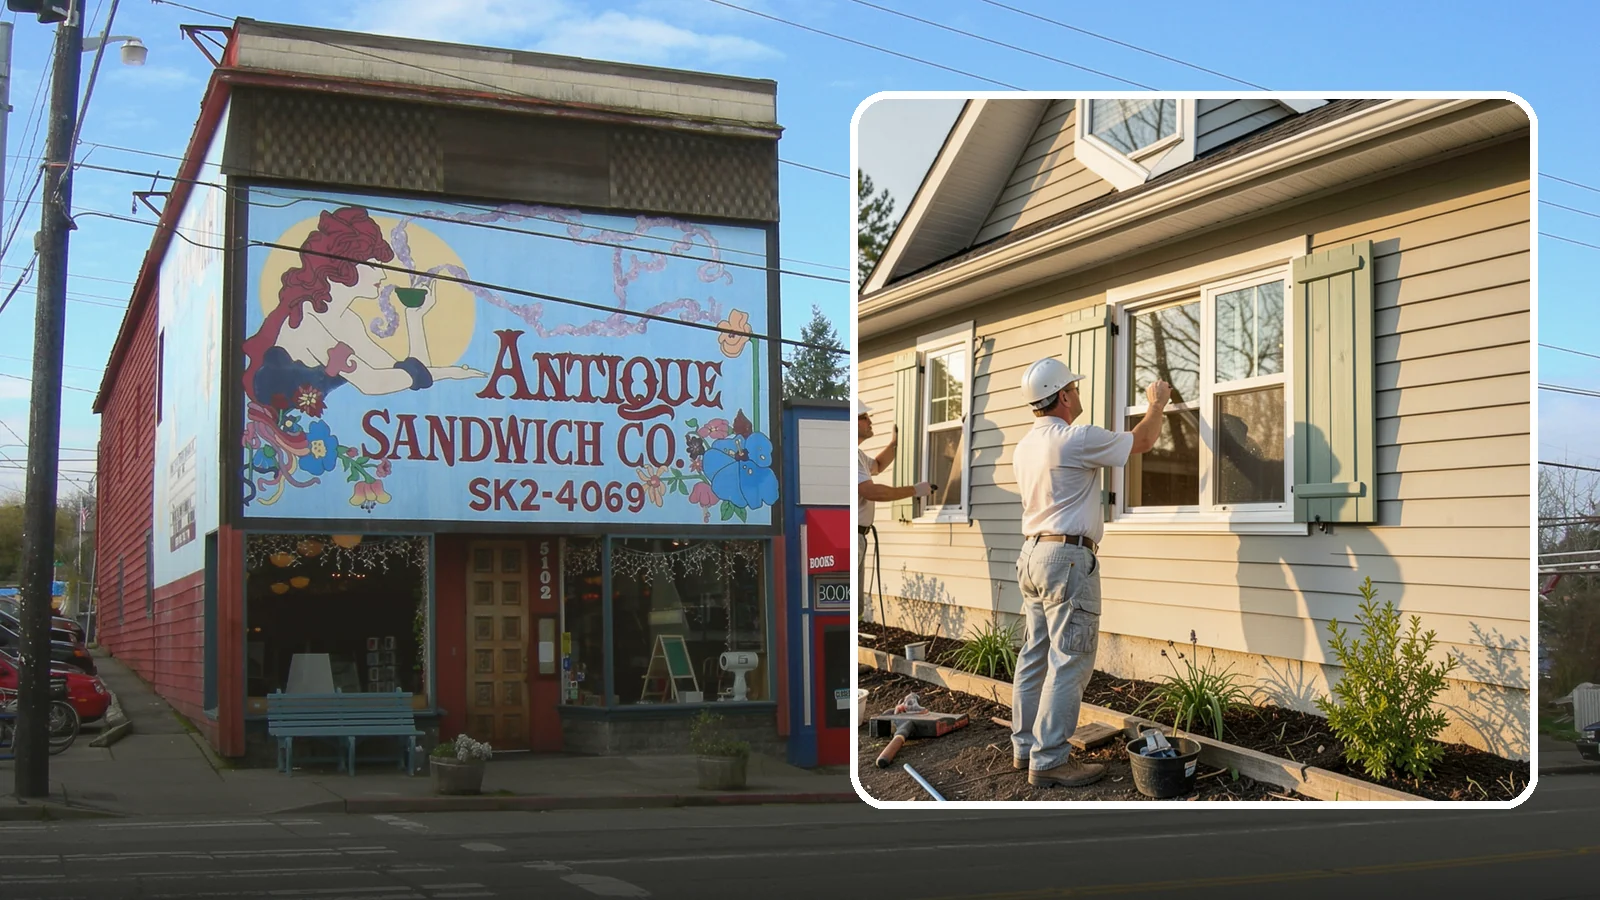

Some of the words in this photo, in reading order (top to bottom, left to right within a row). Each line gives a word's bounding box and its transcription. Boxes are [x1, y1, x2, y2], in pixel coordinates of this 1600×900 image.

[476, 329, 724, 421] ANTIQUE
[360, 409, 604, 467] SANDWICH
[616, 422, 686, 468] CO.
[468, 477, 645, 513] SK2-4069
[540, 541, 551, 599] 5102
[809, 555, 835, 568] BOOKS
